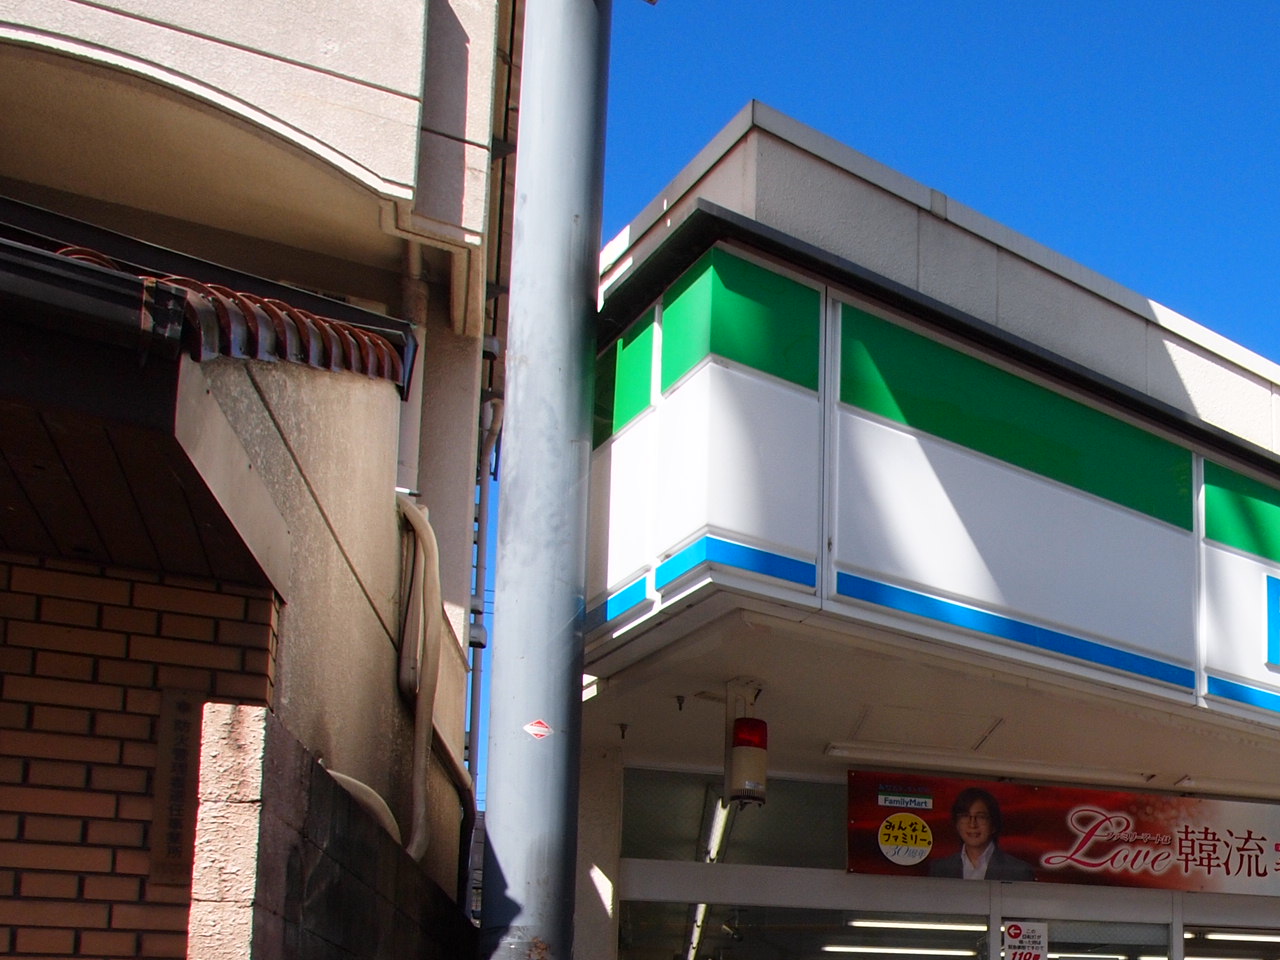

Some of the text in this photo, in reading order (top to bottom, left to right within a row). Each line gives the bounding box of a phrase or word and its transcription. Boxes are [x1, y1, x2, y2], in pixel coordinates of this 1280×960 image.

[884, 797, 928, 807] FamilyMart
[885, 820, 928, 832] みんなと
[1044, 809, 1268, 877] Love 韓流
